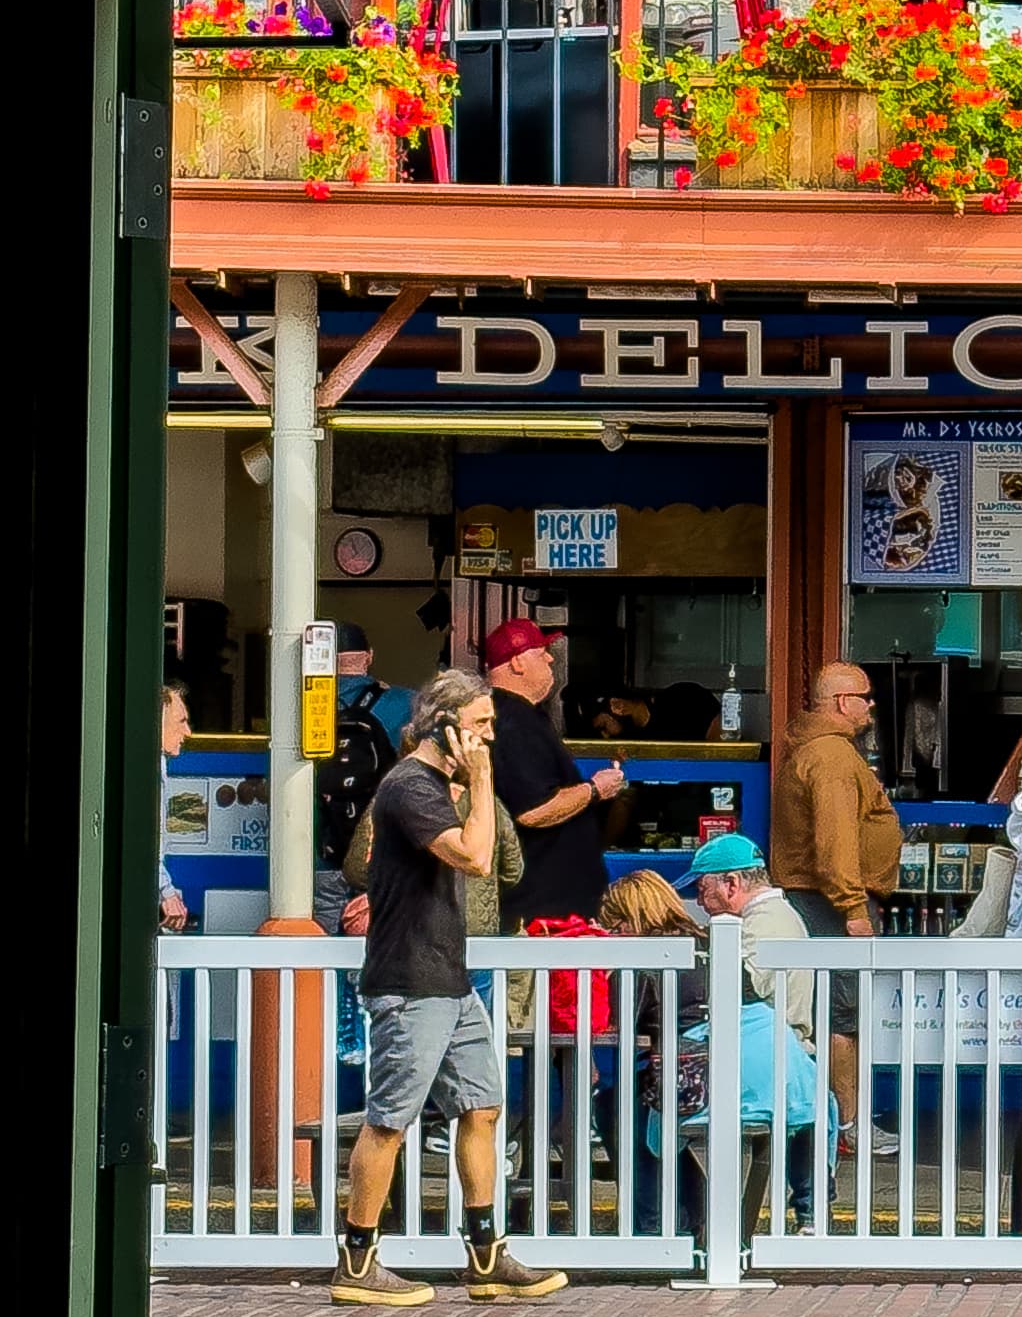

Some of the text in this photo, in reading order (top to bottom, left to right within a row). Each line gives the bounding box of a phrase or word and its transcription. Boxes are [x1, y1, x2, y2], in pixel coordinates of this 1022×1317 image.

[902, 420, 932, 438] MR.
[537, 514, 617, 541] PICK UP
[548, 543, 606, 567] HERE
[882, 1019, 927, 1029] Reseed
